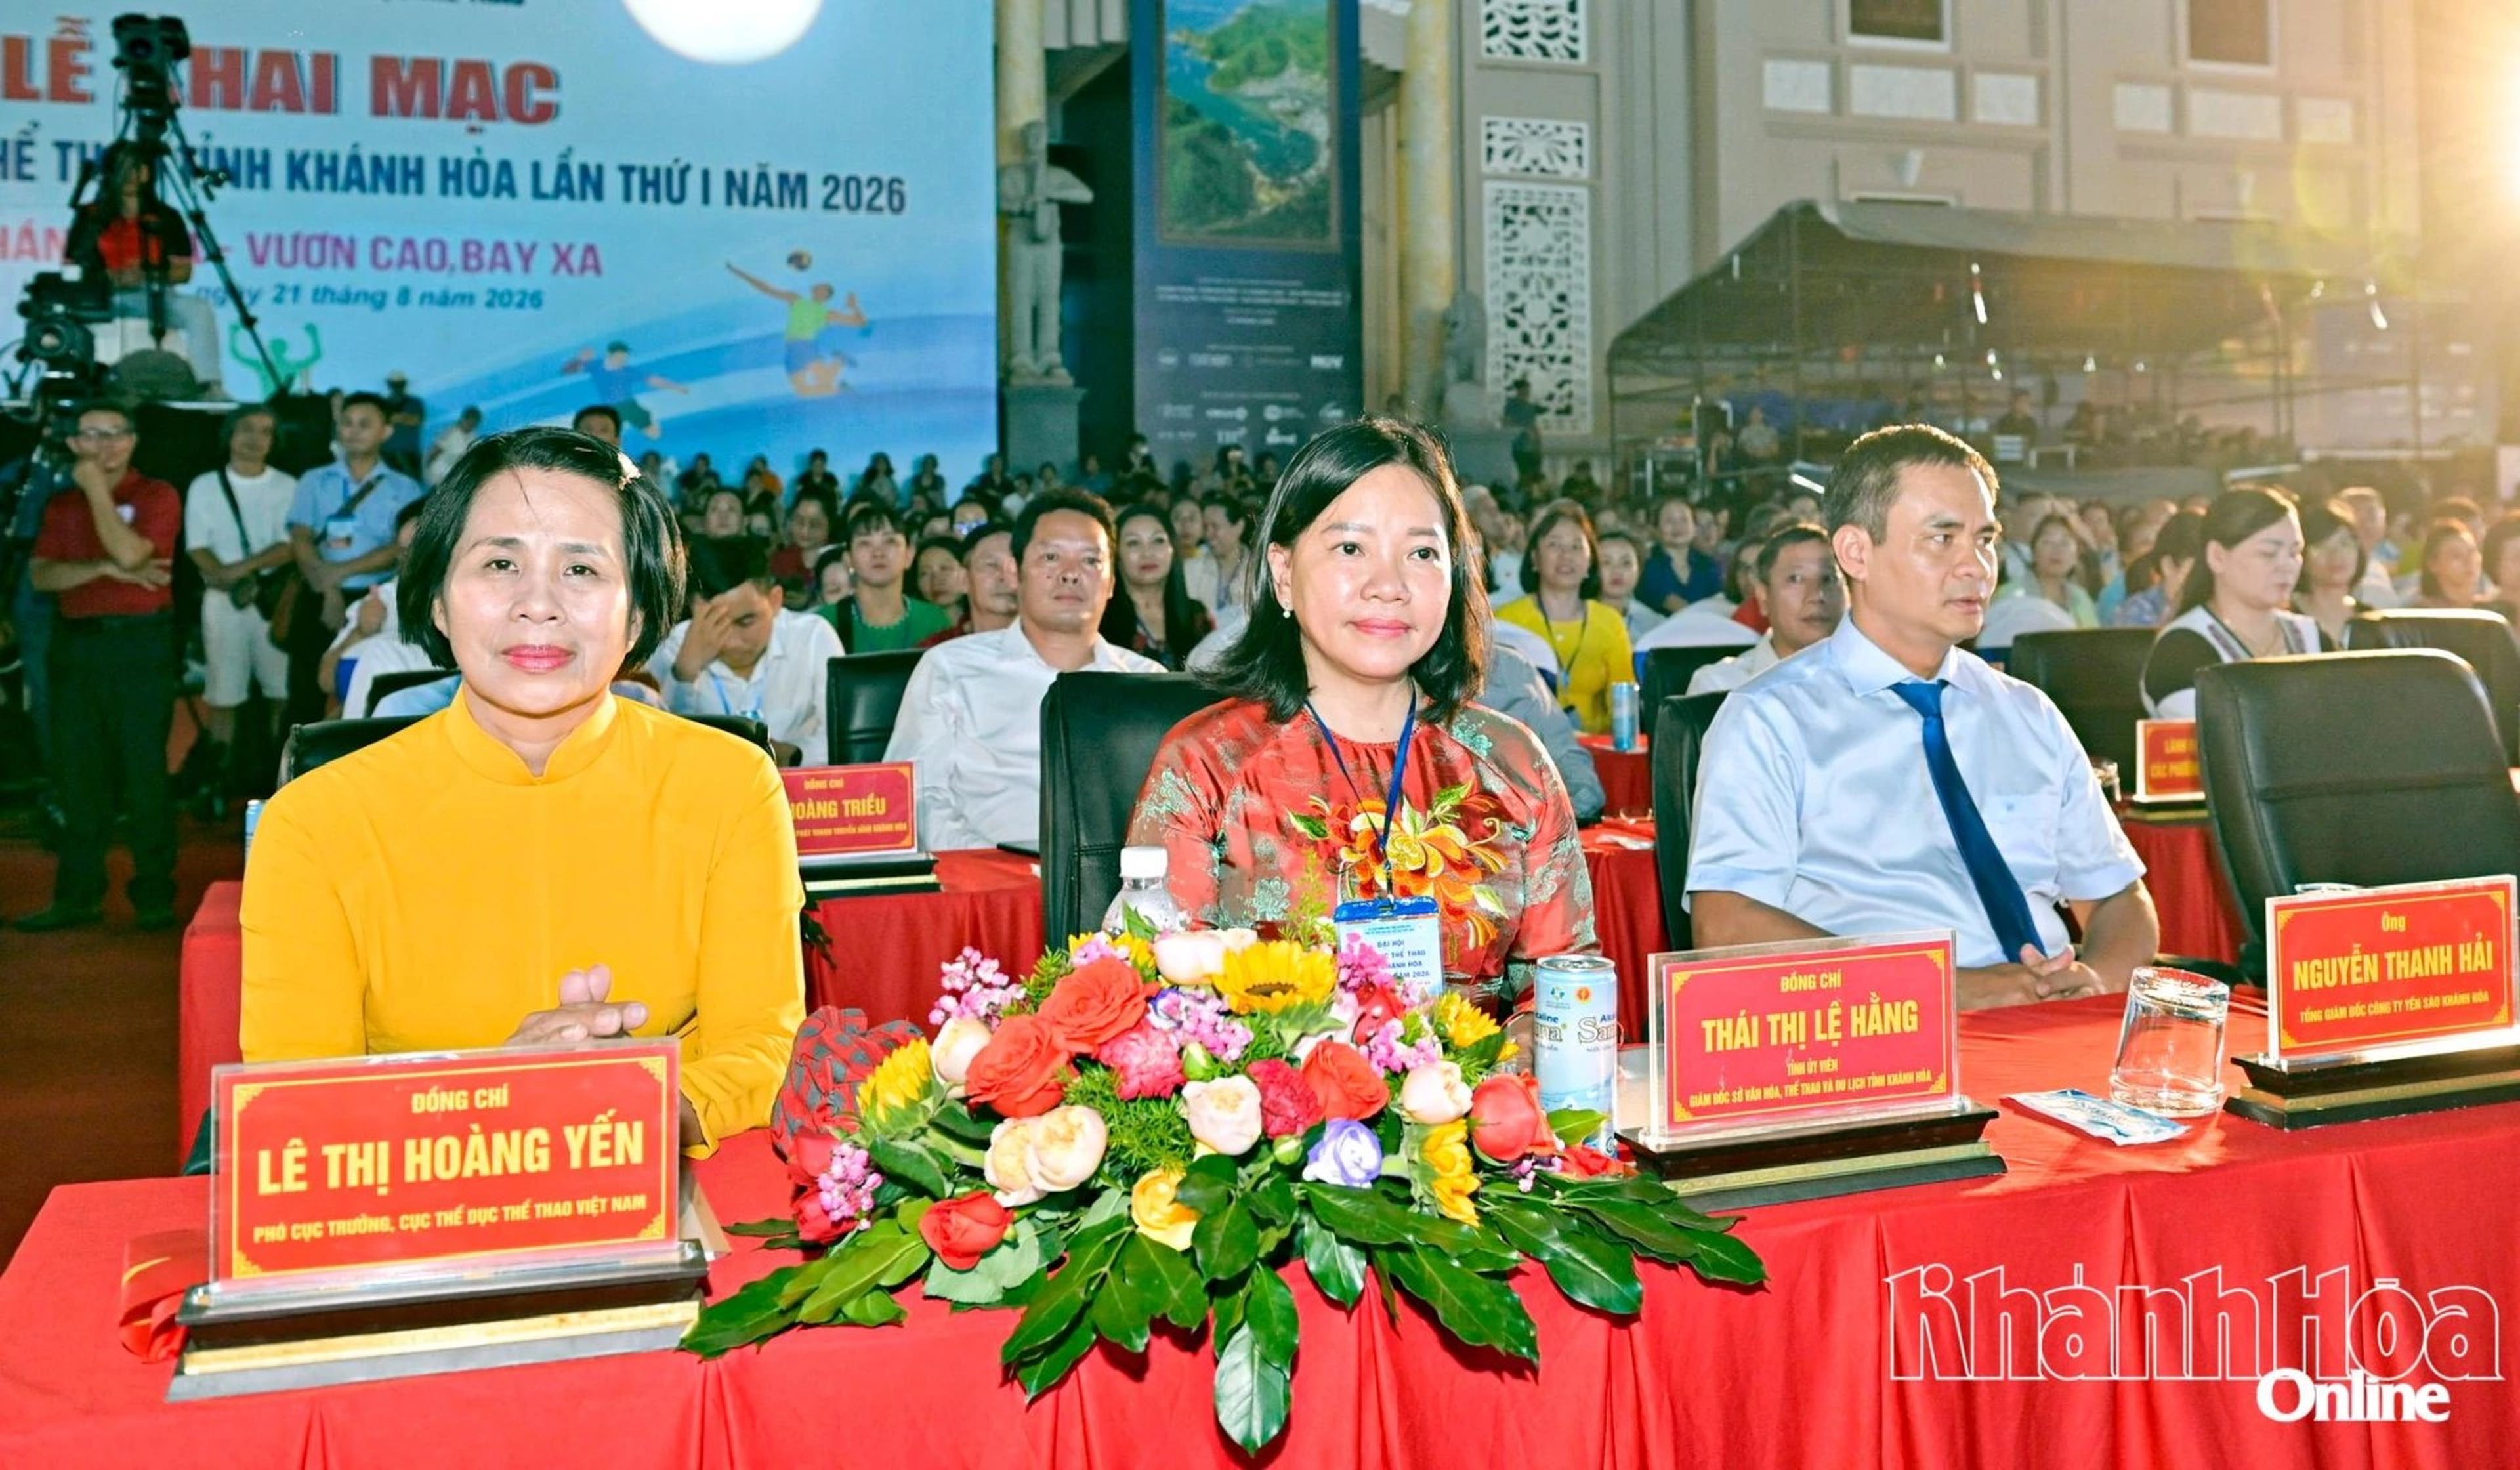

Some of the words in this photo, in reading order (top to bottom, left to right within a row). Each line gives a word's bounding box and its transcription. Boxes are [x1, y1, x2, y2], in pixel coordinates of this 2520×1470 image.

[3, 15, 94, 103] LỄ
[189, 45, 337, 116] HAI
[371, 56, 560, 135] MẠC
[200, 132, 270, 190] ỈNH
[287, 142, 424, 196] KHÁNH
[440, 146, 517, 198] HÒA
[618, 158, 692, 205] THỨ
[702, 168, 710, 206] I
[725, 162, 808, 210] NĂM
[822, 174, 906, 215] 2026
[247, 230, 356, 269] VƯƠN
[551, 241, 603, 277] XA
[197, 285, 261, 308] ngy
[272, 284, 301, 306] 21
[312, 284, 388, 311] tháng
[397, 286, 411, 307] 8
[419, 288, 474, 308] năm
[484, 287, 545, 310] 2026
[2381, 910, 2406, 932] Ông
[1820, 968, 1841, 988] CHÍ
[2294, 943, 2379, 991] NGUYỄN
[2384, 944, 2453, 980] THANH
[2460, 931, 2493, 974] HẢI
[1702, 1009, 1759, 1053] THÁI
[1767, 1011, 1805, 1051] THỊ
[1815, 1001, 1842, 1047] LỆ
[1851, 991, 1918, 1038] HẰNG
[2368, 999, 2391, 1016] CÔNG
[2393, 999, 2403, 1013] TY
[2442, 991, 2471, 1007] KHÁNH
[474, 1083, 509, 1109] CHÍ
[1731, 1086, 1743, 1103] SỞ
[1801, 1082, 1821, 1095] THAO
[1835, 1078, 1846, 1092] DU
[1887, 1071, 1915, 1086] KHÁNH
[258, 1138, 308, 1196] LÊ
[322, 1140, 389, 1196] THỊ
[404, 1124, 550, 1183] HOÀNG
[563, 1108, 643, 1169] YẾN
[253, 1223, 287, 1243] PHÓ
[291, 1221, 323, 1242] CỤC
[399, 1213, 431, 1232] CỤC
[435, 1204, 465, 1227] THỂ
[467, 1207, 498, 1227] DỤC
[502, 1198, 531, 1221] THỂ
[534, 1200, 572, 1219] THAO
[576, 1195, 608, 1217] VIỆT
[611, 1194, 647, 1212] NAM
